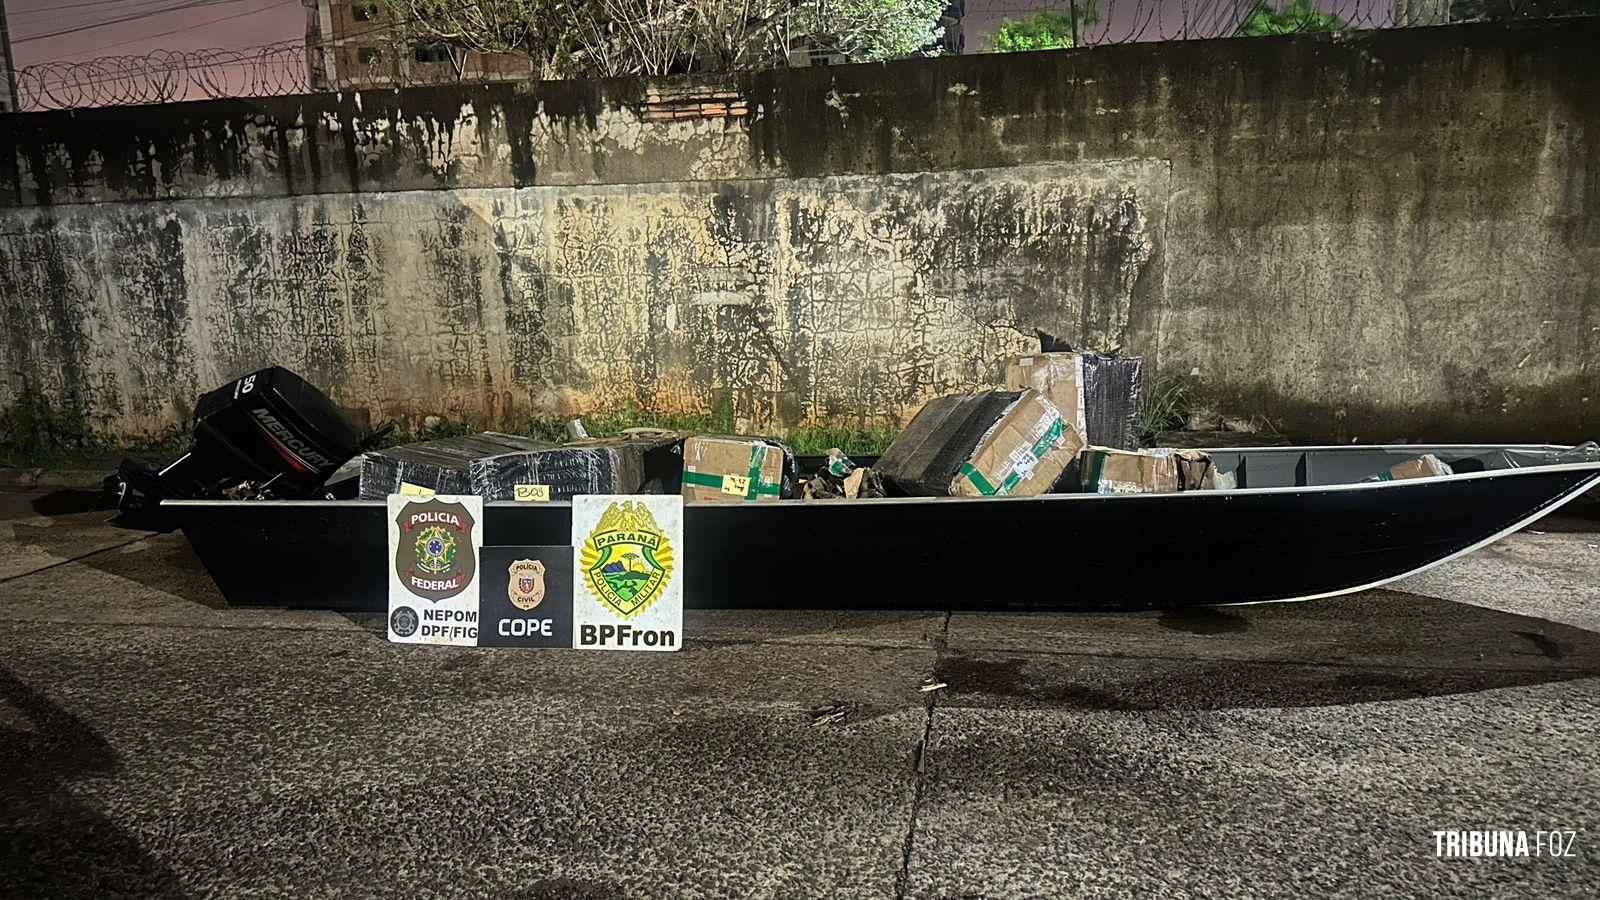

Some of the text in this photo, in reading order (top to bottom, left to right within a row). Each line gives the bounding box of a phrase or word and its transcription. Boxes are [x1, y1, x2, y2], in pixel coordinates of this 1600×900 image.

[242, 374, 257, 394] 50
[252, 408, 336, 468] MERCURY
[411, 511, 460, 526] POLICIA
[597, 533, 657, 547] PARANÁ
[411, 576, 459, 590] FEDERAL
[630, 572, 661, 607] MILITAR
[423, 609, 477, 622] NEPOM
[421, 624, 478, 639] DPF/FIG
[498, 618, 553, 636] COPE
[580, 624, 675, 647] BPFron
